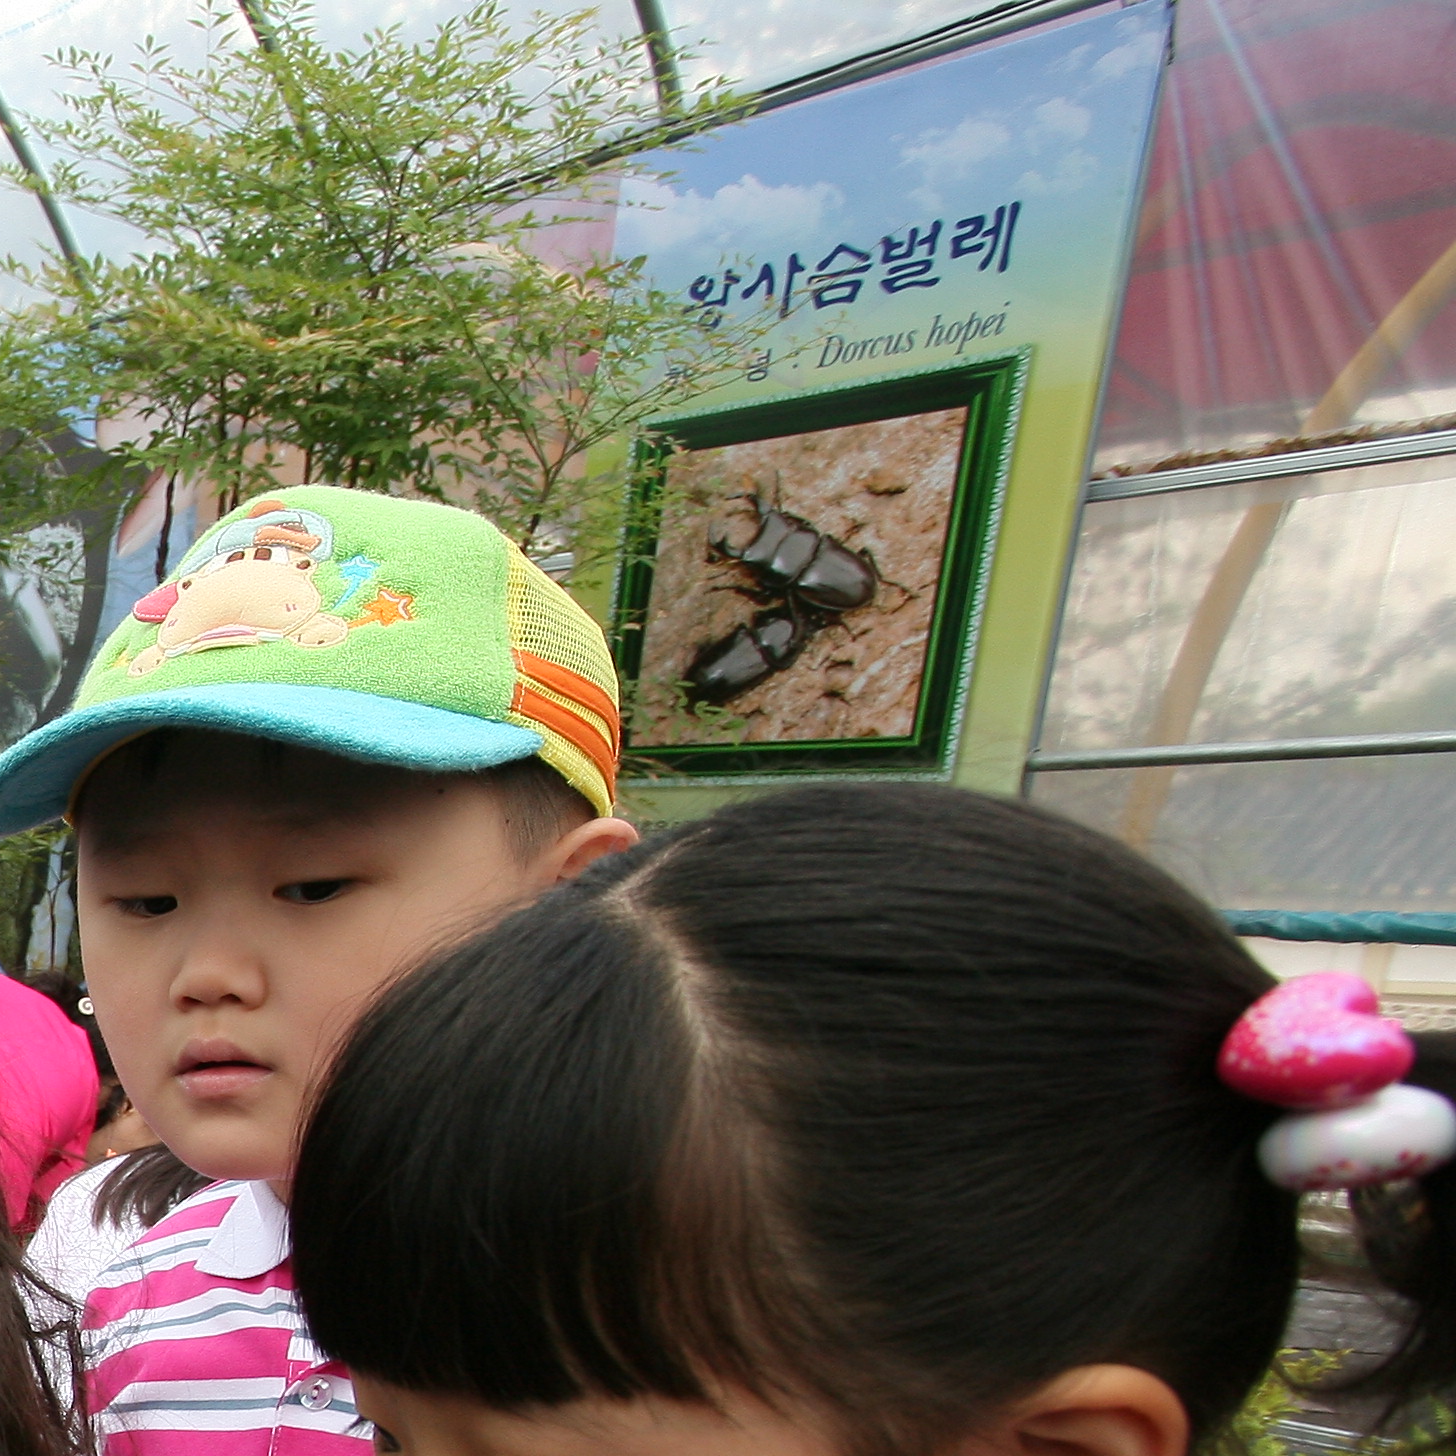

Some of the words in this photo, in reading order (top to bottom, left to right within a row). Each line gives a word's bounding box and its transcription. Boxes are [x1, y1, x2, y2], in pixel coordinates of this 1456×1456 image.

[683, 199, 1023, 333] 왕사슴벌레
[816, 333, 918, 369] Dorcus
[924, 301, 1012, 355] hopei
